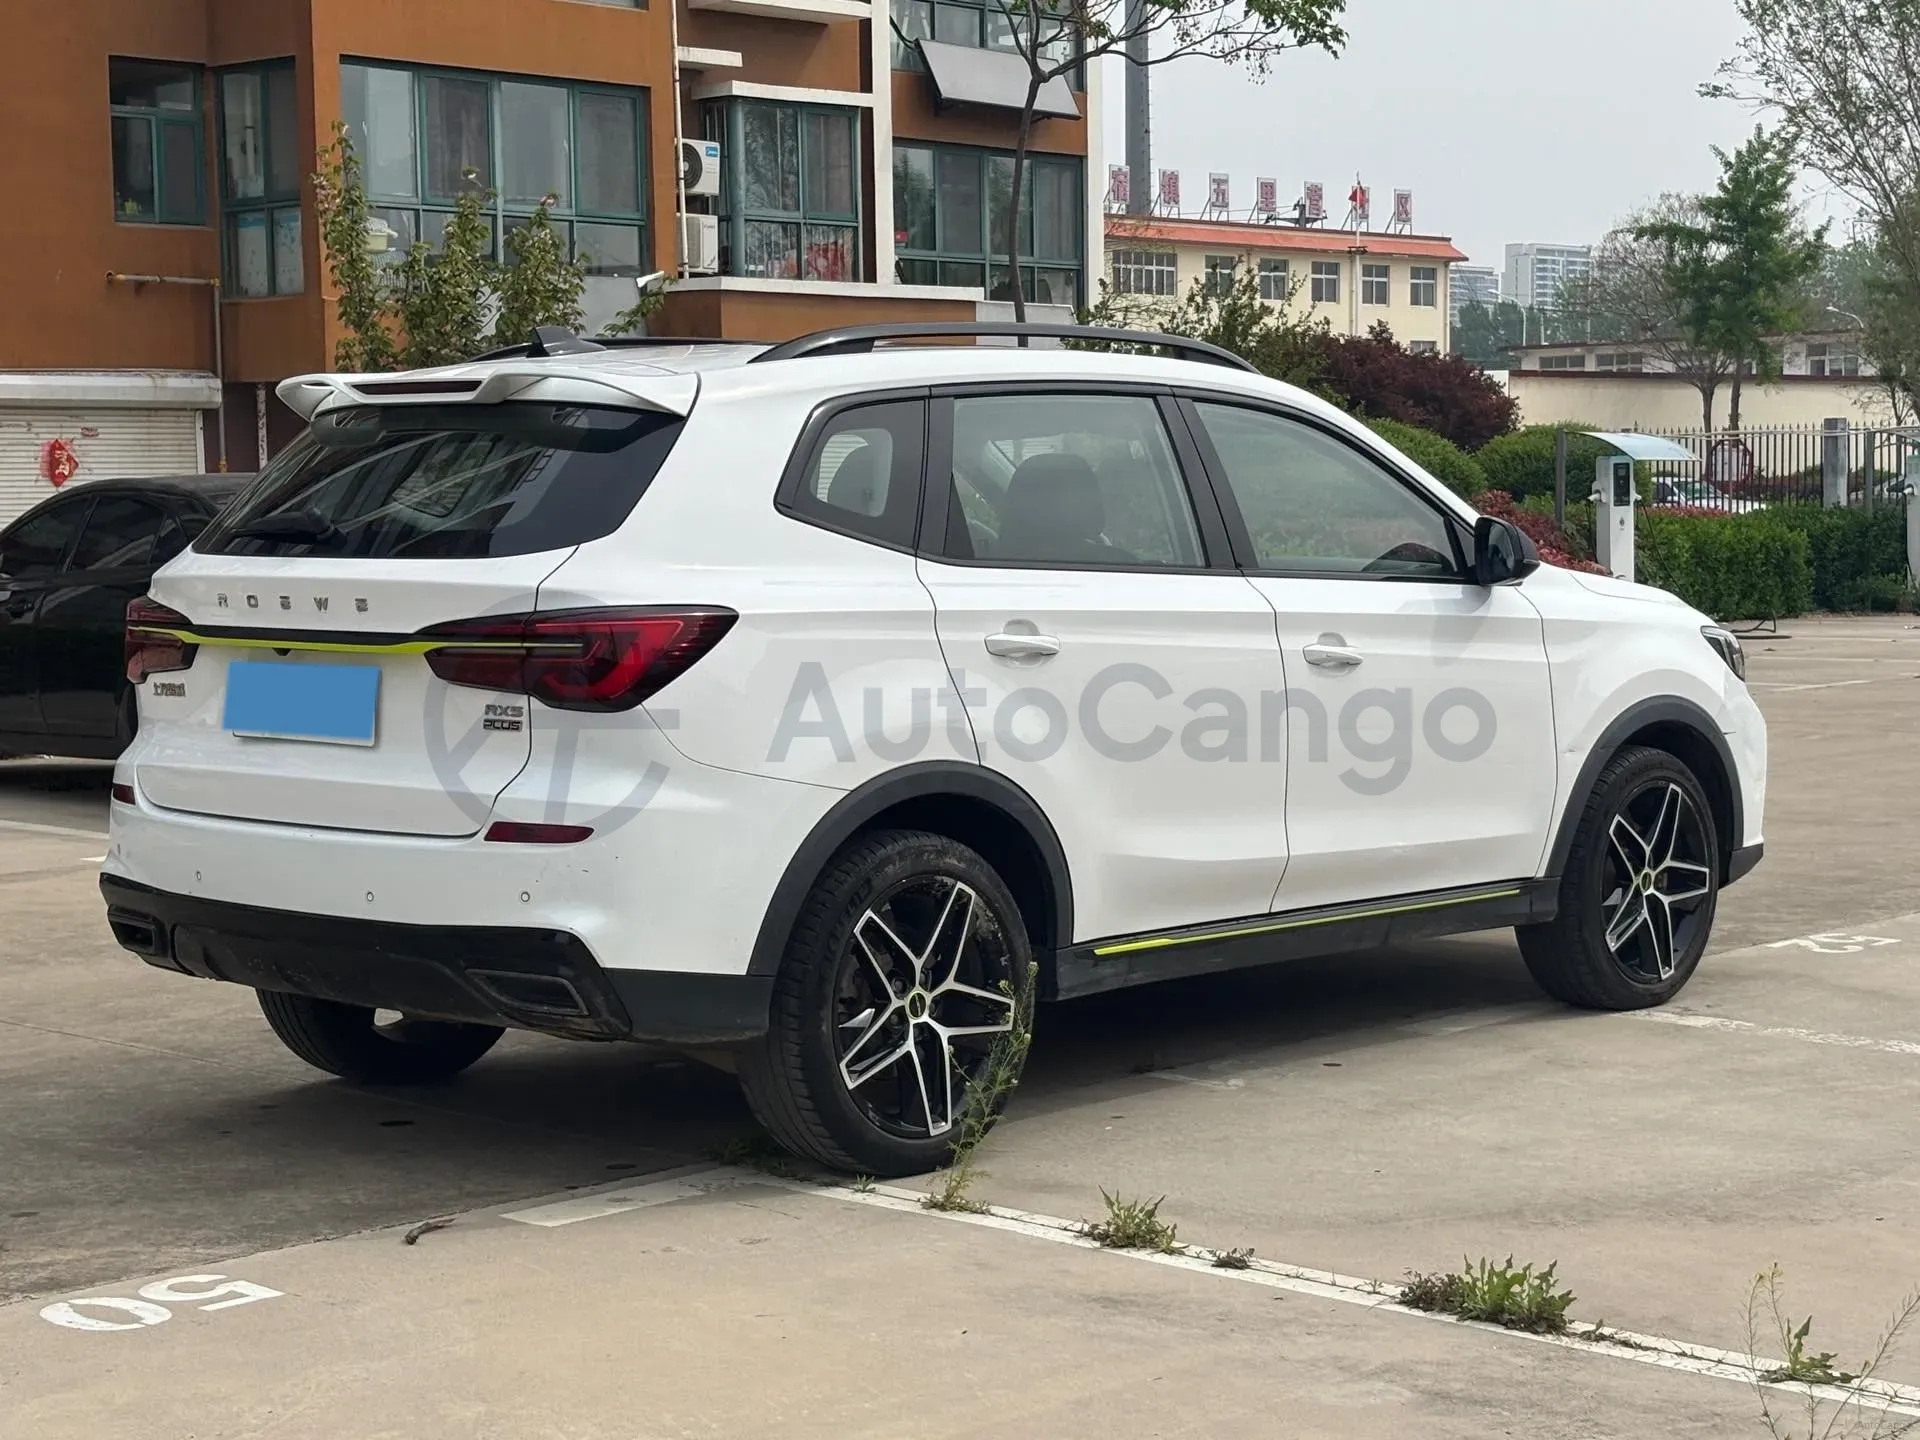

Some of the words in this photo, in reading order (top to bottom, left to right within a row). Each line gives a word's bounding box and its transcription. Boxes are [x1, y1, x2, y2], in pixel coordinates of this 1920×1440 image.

[217, 592, 369, 612] ROEWE
[485, 704, 524, 718] RX5
[40, 1274, 286, 1331] 50
